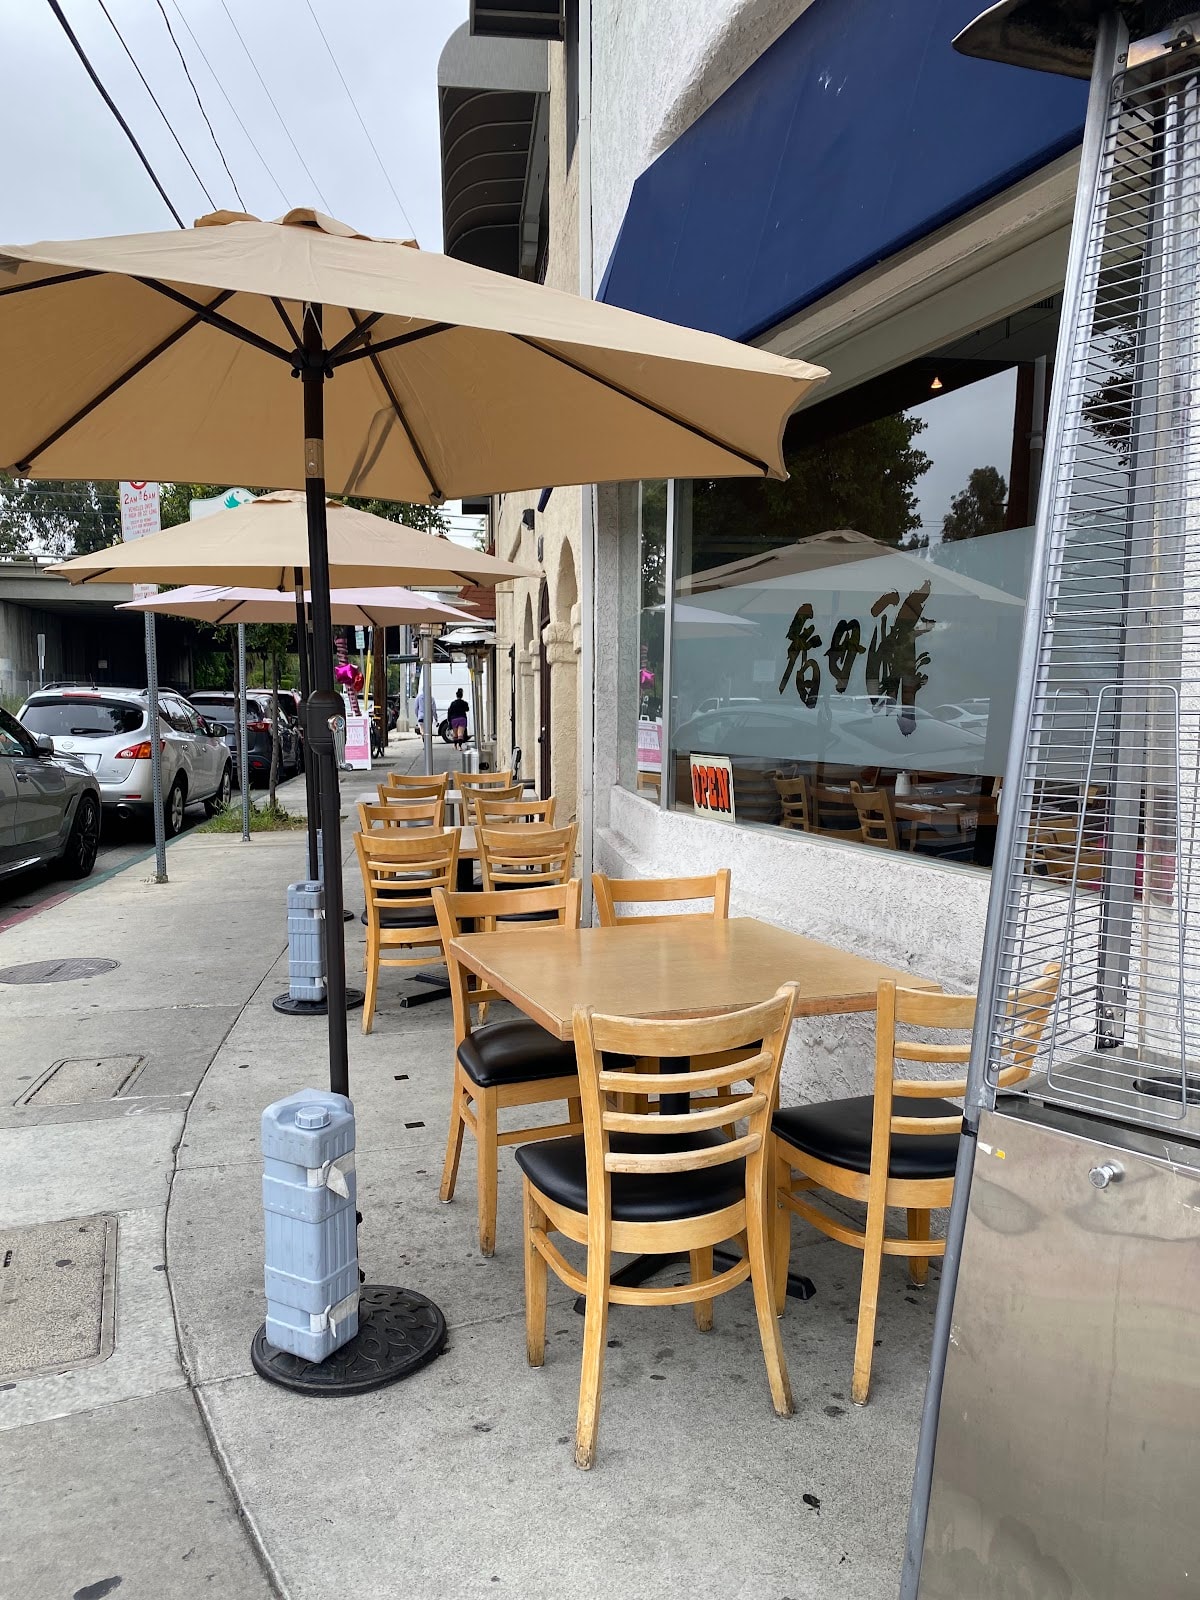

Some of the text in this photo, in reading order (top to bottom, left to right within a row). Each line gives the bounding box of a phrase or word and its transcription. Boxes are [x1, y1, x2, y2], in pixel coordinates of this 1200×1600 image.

[124, 493, 138, 504] 2AM
[143, 490, 155, 501] 6AM
[692, 764, 731, 813] OPEN
